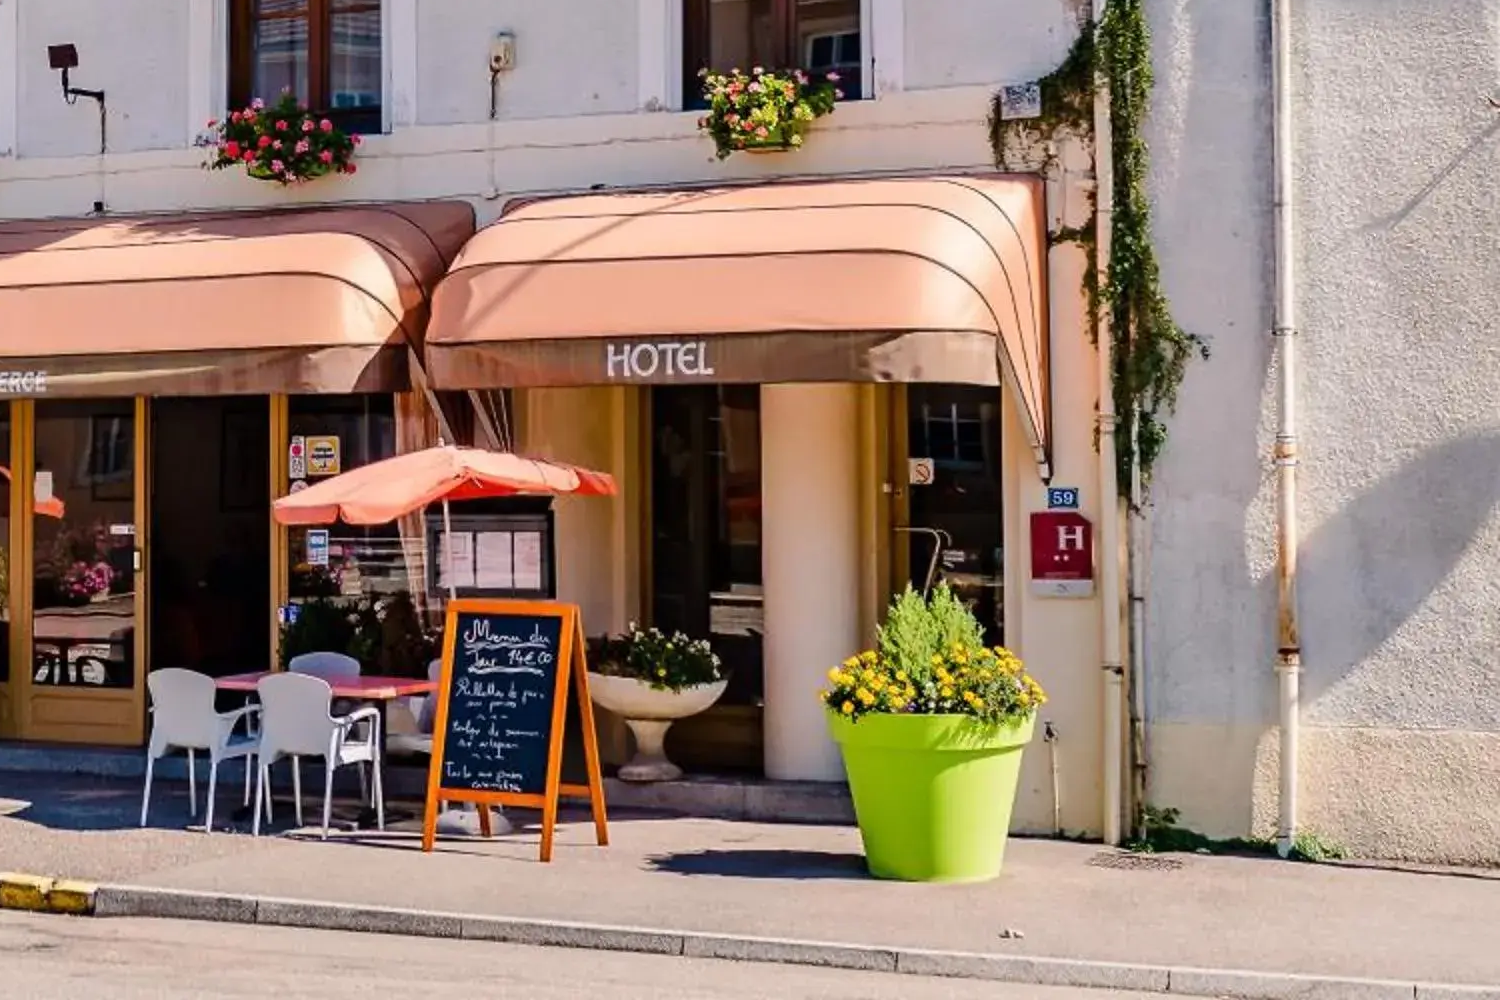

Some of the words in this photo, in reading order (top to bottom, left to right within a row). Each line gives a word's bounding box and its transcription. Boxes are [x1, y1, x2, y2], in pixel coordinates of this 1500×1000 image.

[607, 342, 714, 377] HOTEL
[1052, 491, 1074, 505] 59
[1057, 525, 1084, 550] H
[463, 618, 522, 644] Menu
